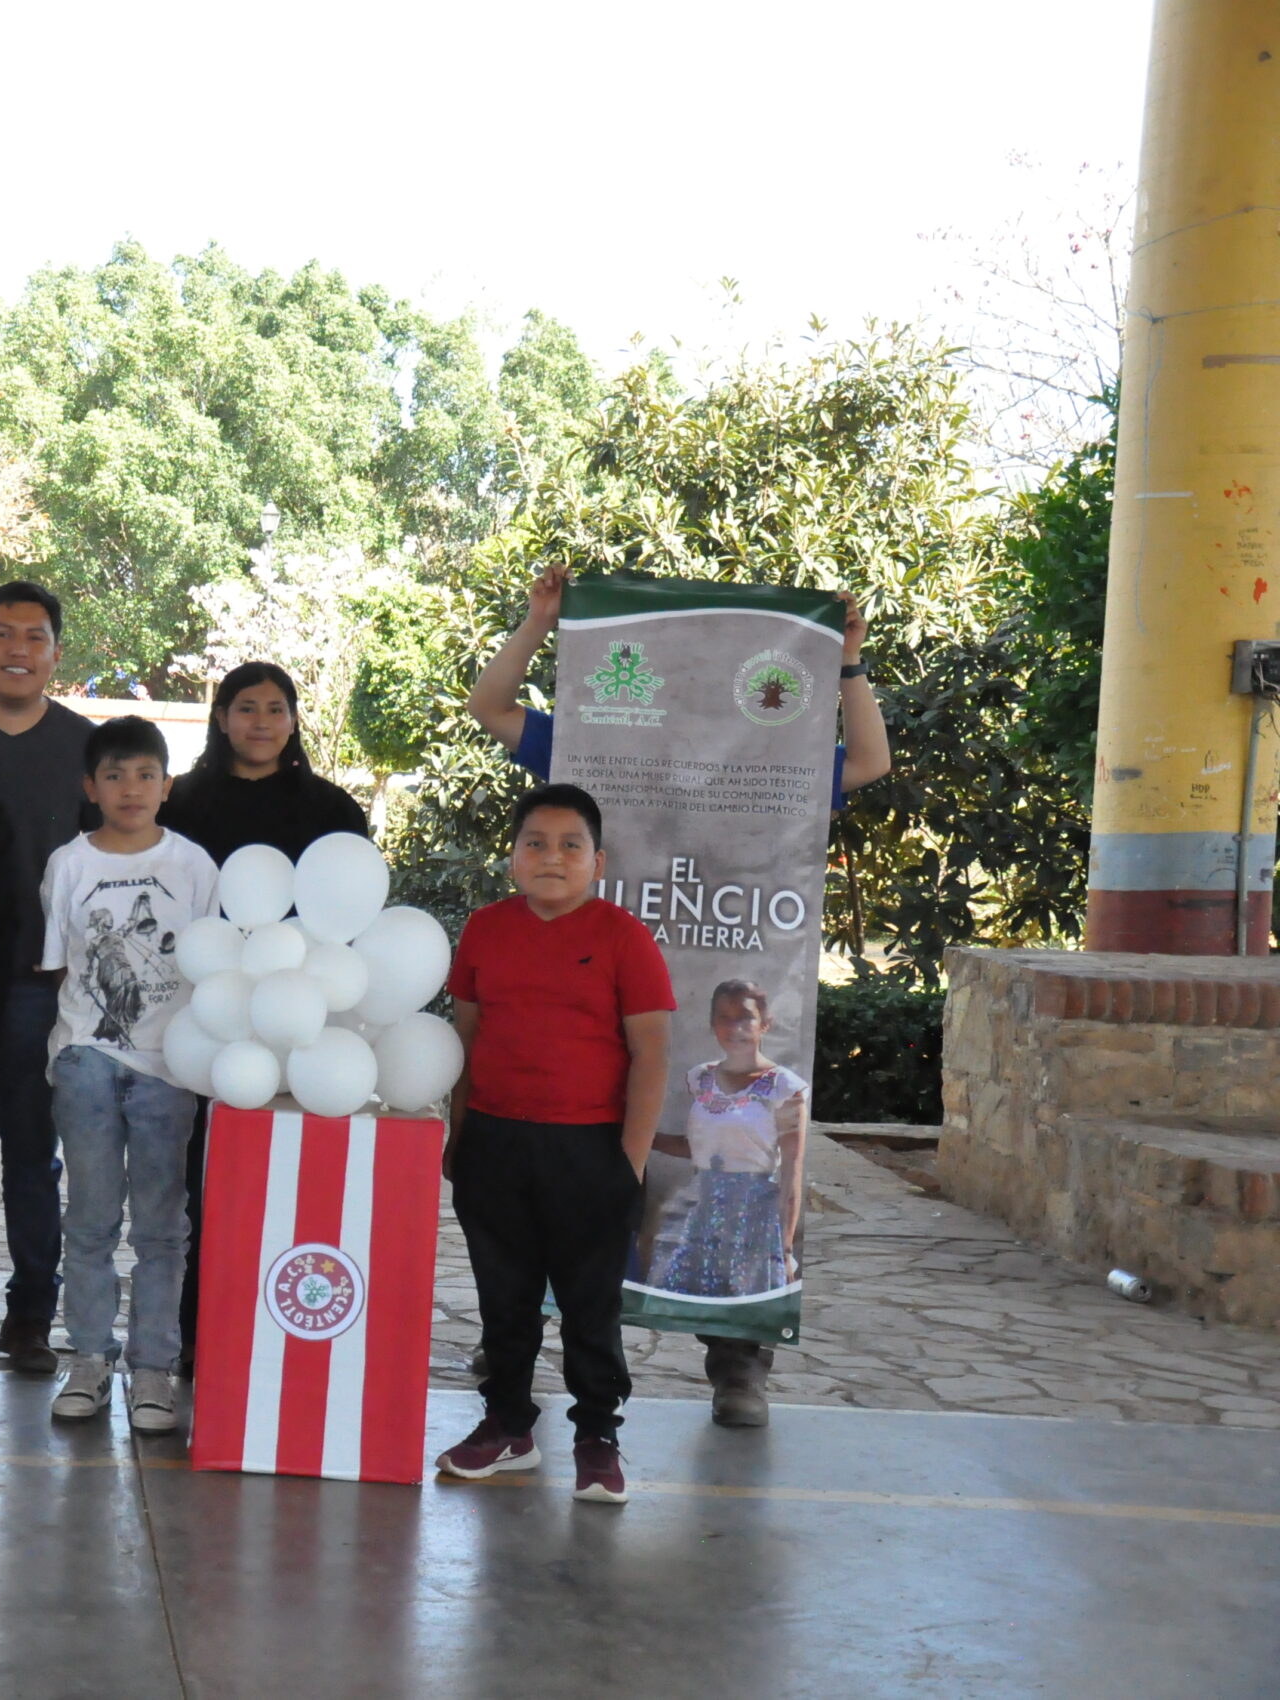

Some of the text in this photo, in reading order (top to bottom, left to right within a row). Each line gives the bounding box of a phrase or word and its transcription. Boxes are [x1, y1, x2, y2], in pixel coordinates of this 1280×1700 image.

[568, 754, 816, 777] UN VIAJE ENTRE LOS RECUERDOS Y LA VIDA PRESENTE
[572, 768, 584, 777] DE
[620, 770, 640, 780] UNA
[642, 772, 670, 782] MUJER
[672, 774, 701, 784] RURAL
[704, 776, 724, 786] QUE
[727, 778, 741, 786] AH
[743, 778, 767, 787] SIDO
[586, 783, 598, 792] LA
[600, 783, 691, 798] TRANSFORMACIÓN
[693, 790, 705, 798] DE
[708, 790, 720, 799] SU
[722, 790, 786, 801] COMUNIDAD
[788, 792, 794, 802] Y
[796, 794, 808, 804] DE
[623, 798, 646, 808] VIDA
[646, 800, 654, 808] A
[656, 800, 688, 811] PARTIR
[688, 802, 706, 813] DEL
[709, 804, 750, 814] CAMBIO
[752, 804, 808, 818] CLIMÁTICO
[671, 857, 701, 883] EL
[81, 875, 177, 906] METALLICA
[597, 879, 806, 931] ILENCIO
[677, 924, 764, 952] TIERRA
[278, 1266, 348, 1330] CENTÉOTL A.C.
